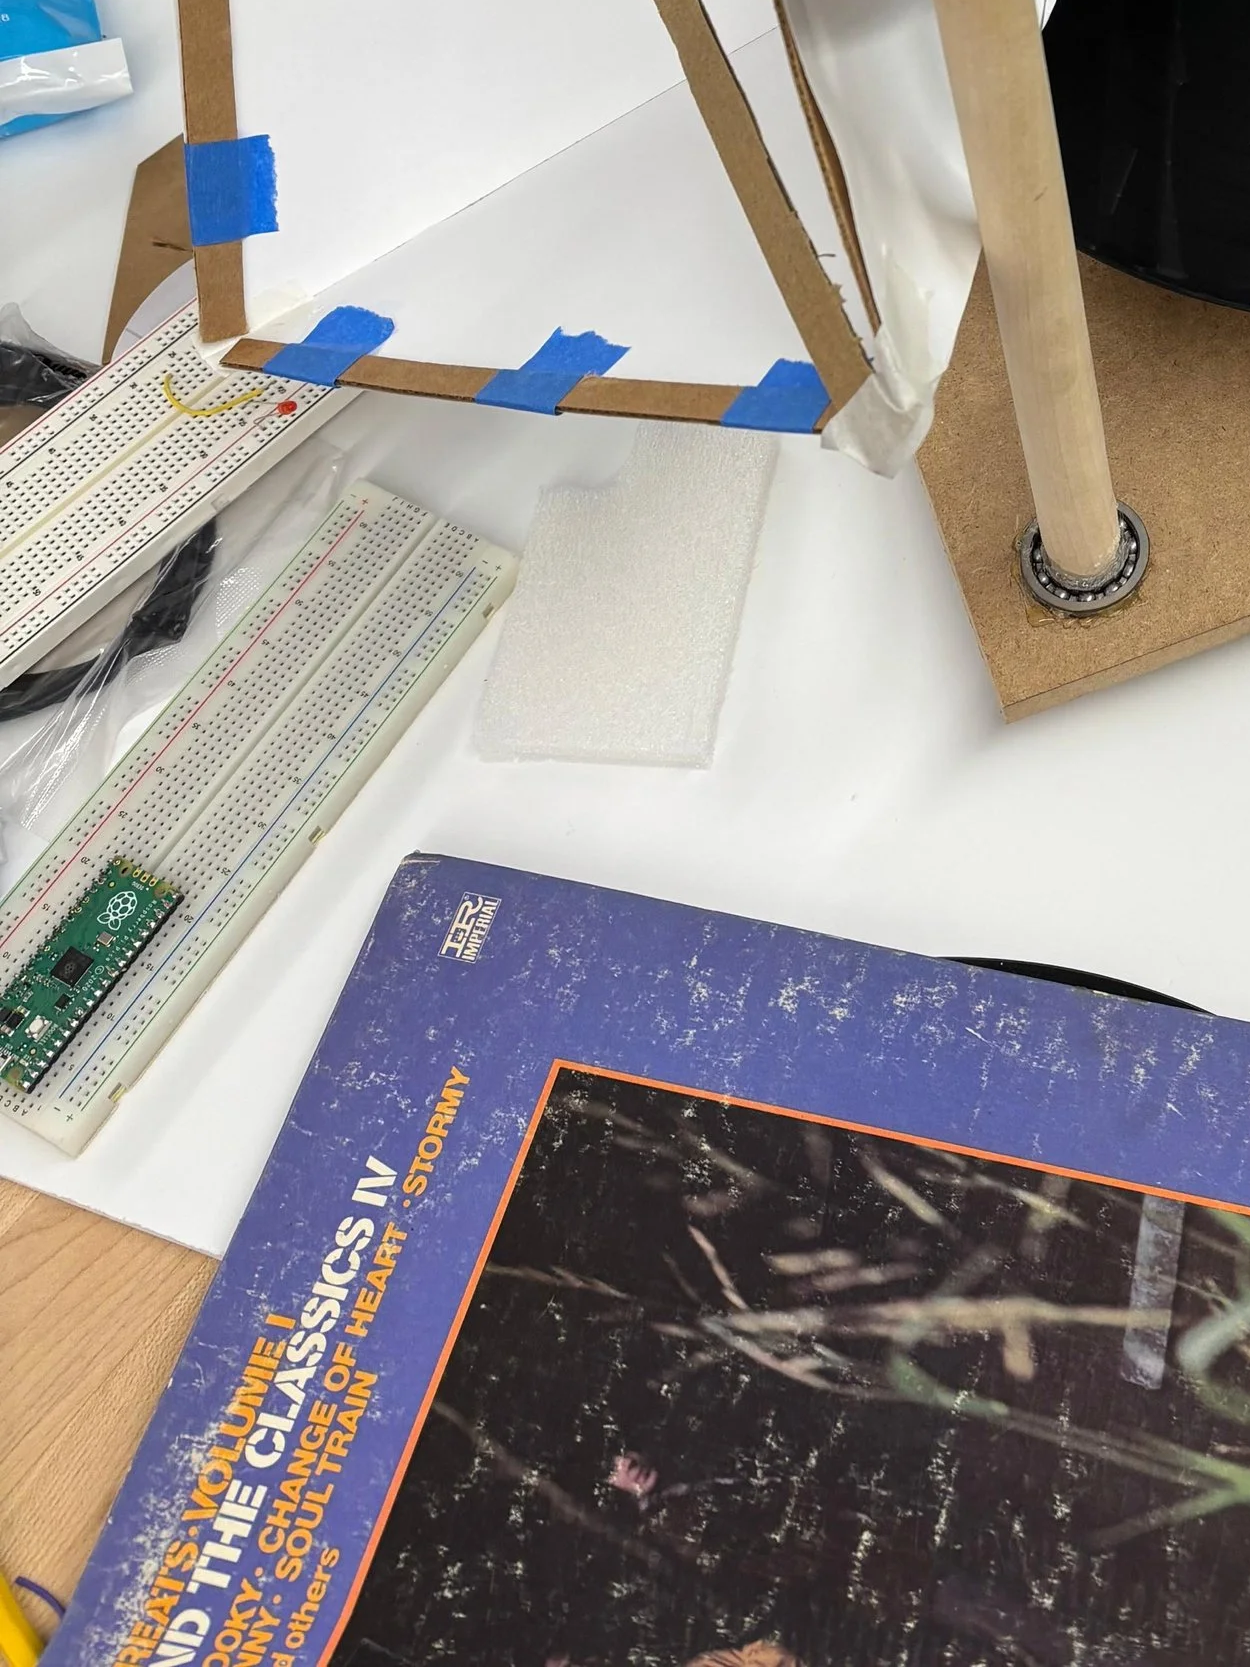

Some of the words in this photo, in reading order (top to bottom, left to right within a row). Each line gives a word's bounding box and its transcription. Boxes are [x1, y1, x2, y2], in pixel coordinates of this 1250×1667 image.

[81, 973, 96, 992] 2020
[126, 898, 157, 933] Raspberry
[461, 897, 499, 961] IMPERIAL
[184, 1471, 270, 1605] THE
[239, 1208, 379, 1475] CLASSICS
[350, 1153, 400, 1212] IV
[252, 1396, 341, 1558] CHANGE
[321, 1340, 362, 1395] OF
[345, 1220, 411, 1338] HEART
[400, 1064, 473, 1199] STORMY
[179, 1333, 288, 1532] VOLUME
[263, 1308, 297, 1334] I
[271, 1477, 336, 1584] SOUL
[313, 1366, 380, 1481] TRAIN
[277, 1540, 344, 1654] others
